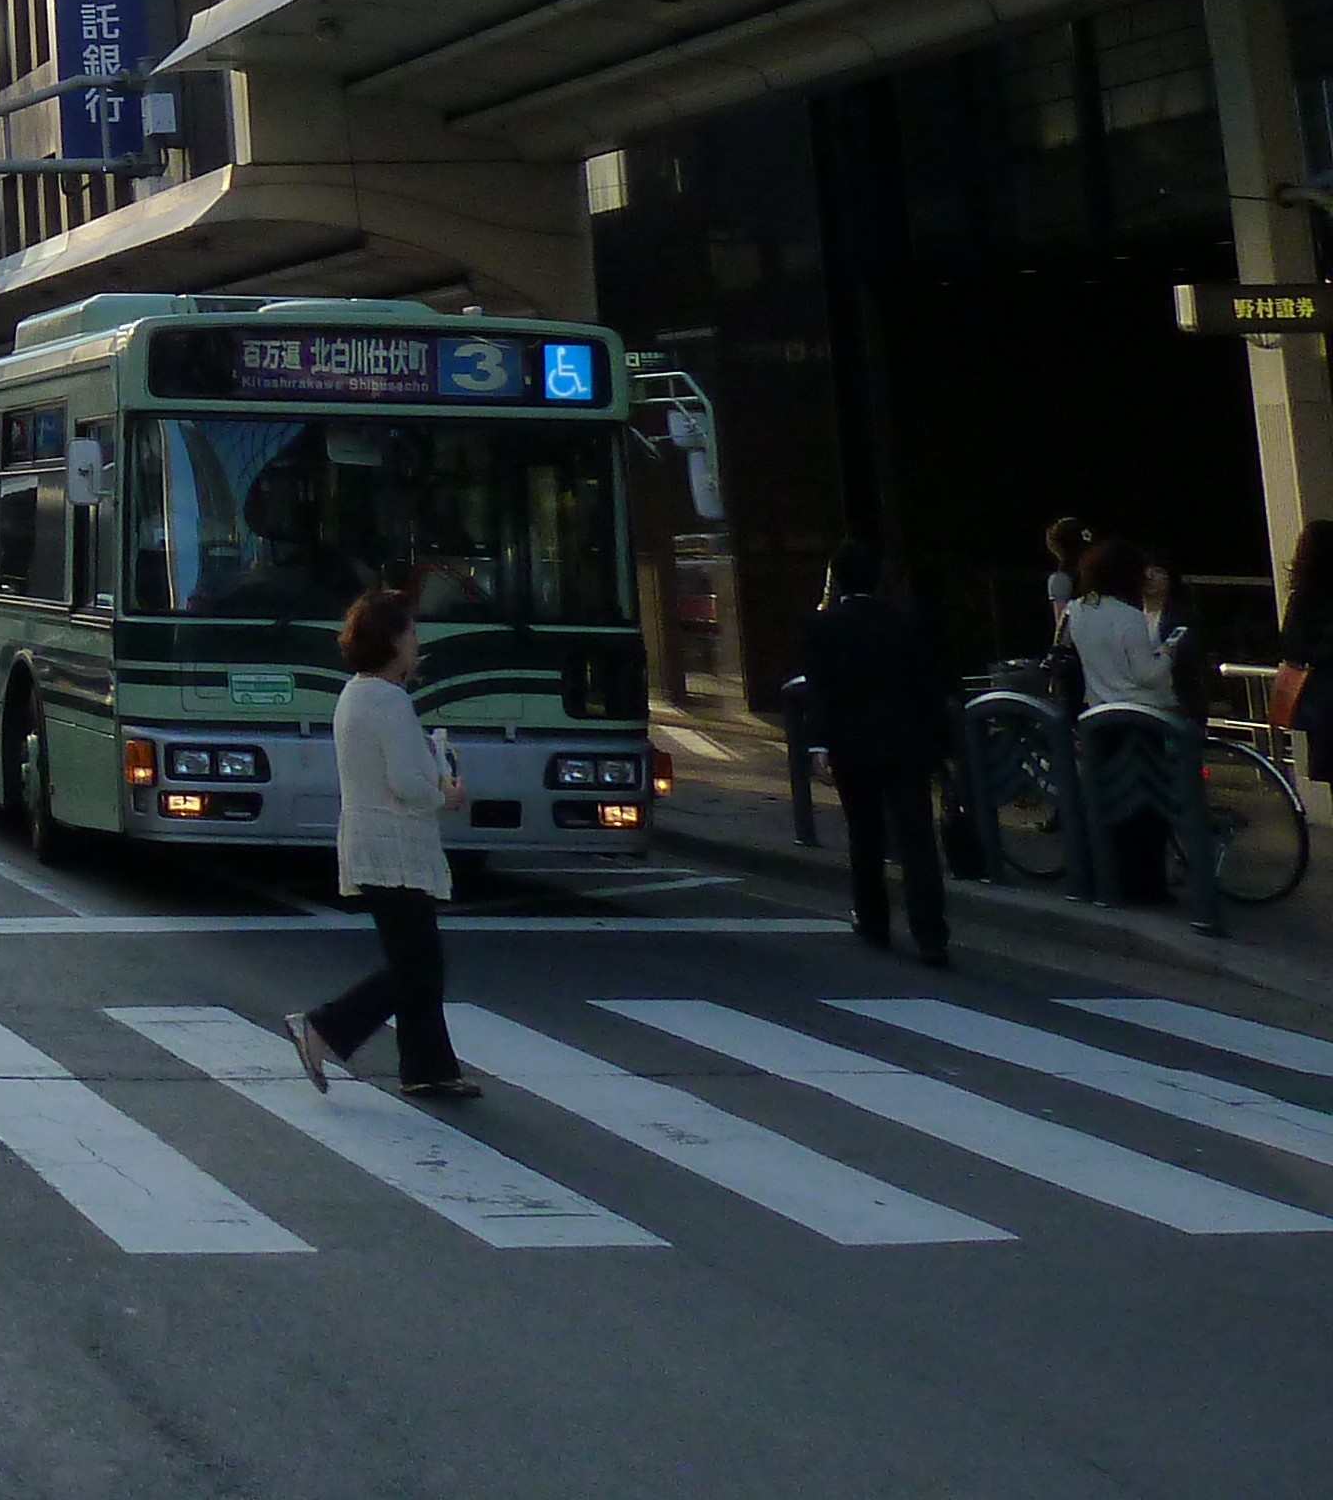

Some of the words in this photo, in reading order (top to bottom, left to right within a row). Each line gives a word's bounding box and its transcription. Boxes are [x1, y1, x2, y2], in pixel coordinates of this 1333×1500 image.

[1233, 297, 1316, 319] 野村證券
[450, 342, 509, 392] 3
